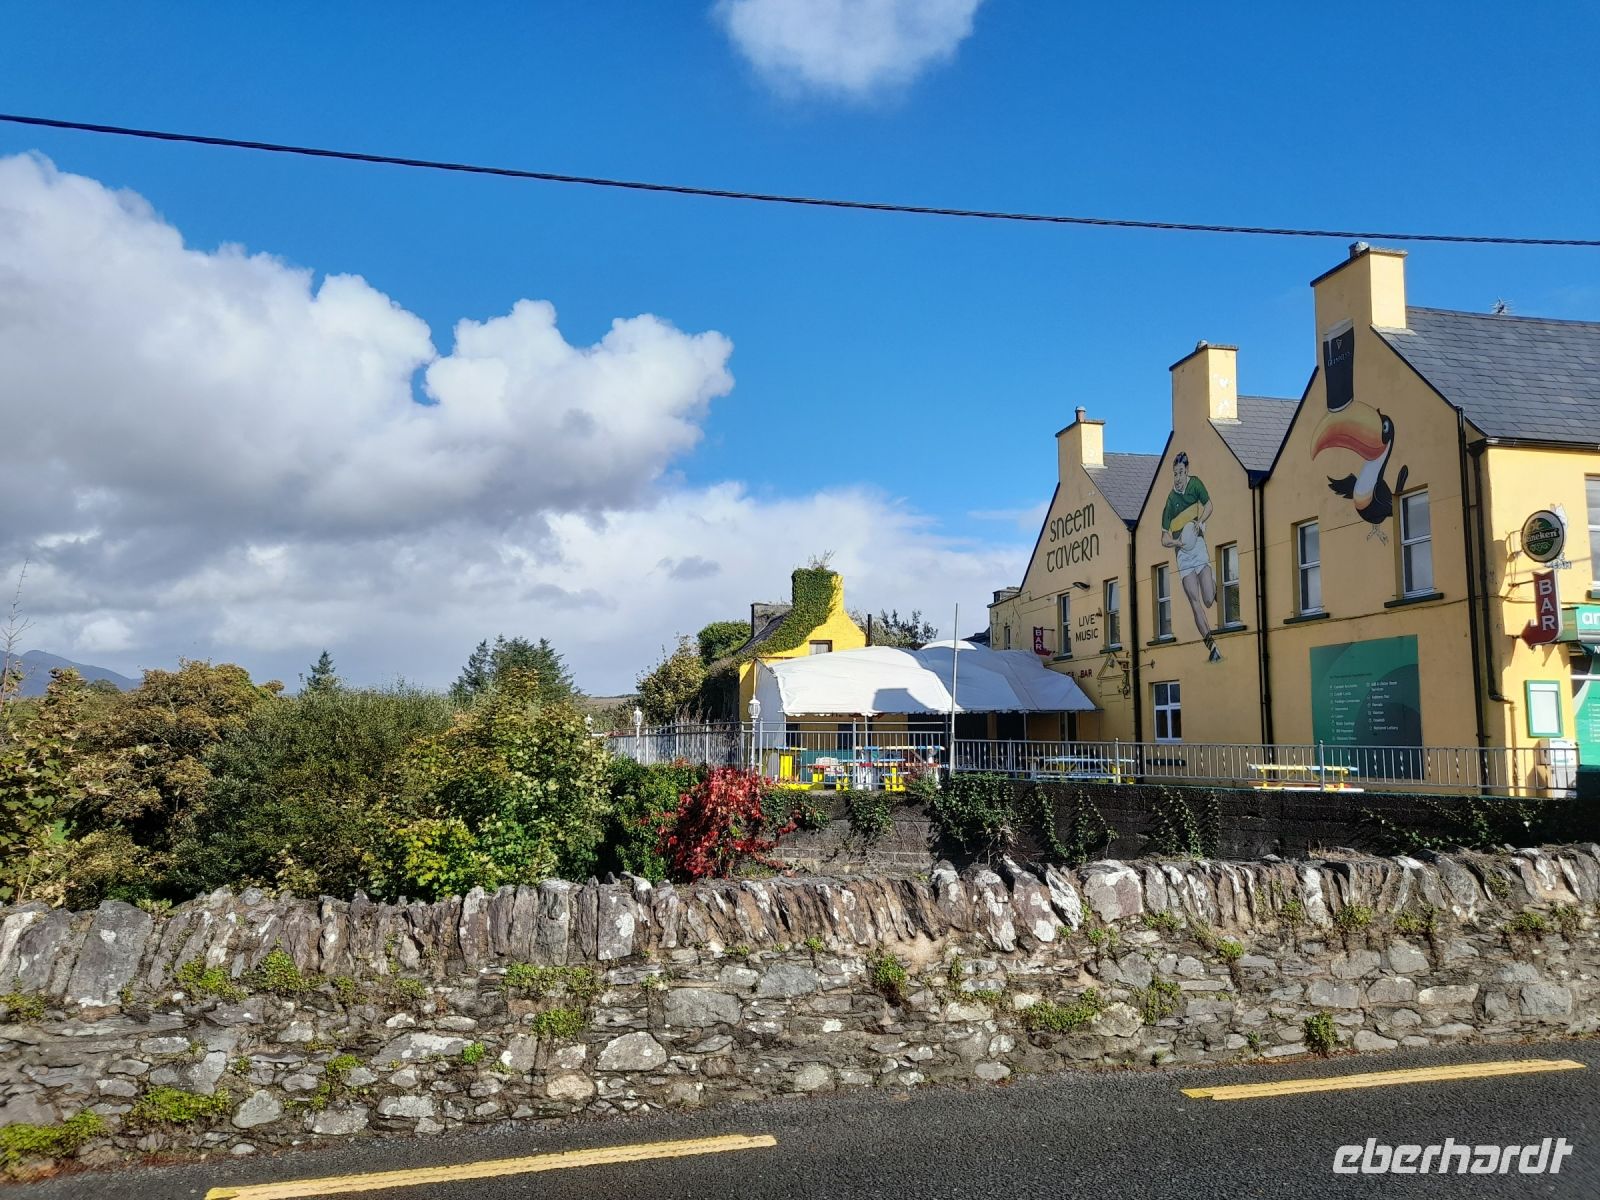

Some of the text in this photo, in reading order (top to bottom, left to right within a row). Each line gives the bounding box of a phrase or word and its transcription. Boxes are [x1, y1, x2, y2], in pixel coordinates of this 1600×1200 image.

[1538, 579, 1556, 631] BAR
[1078, 613, 1096, 627] LIVE
[1075, 628, 1099, 642] MUSIC
[1080, 668, 1093, 679] BAR
